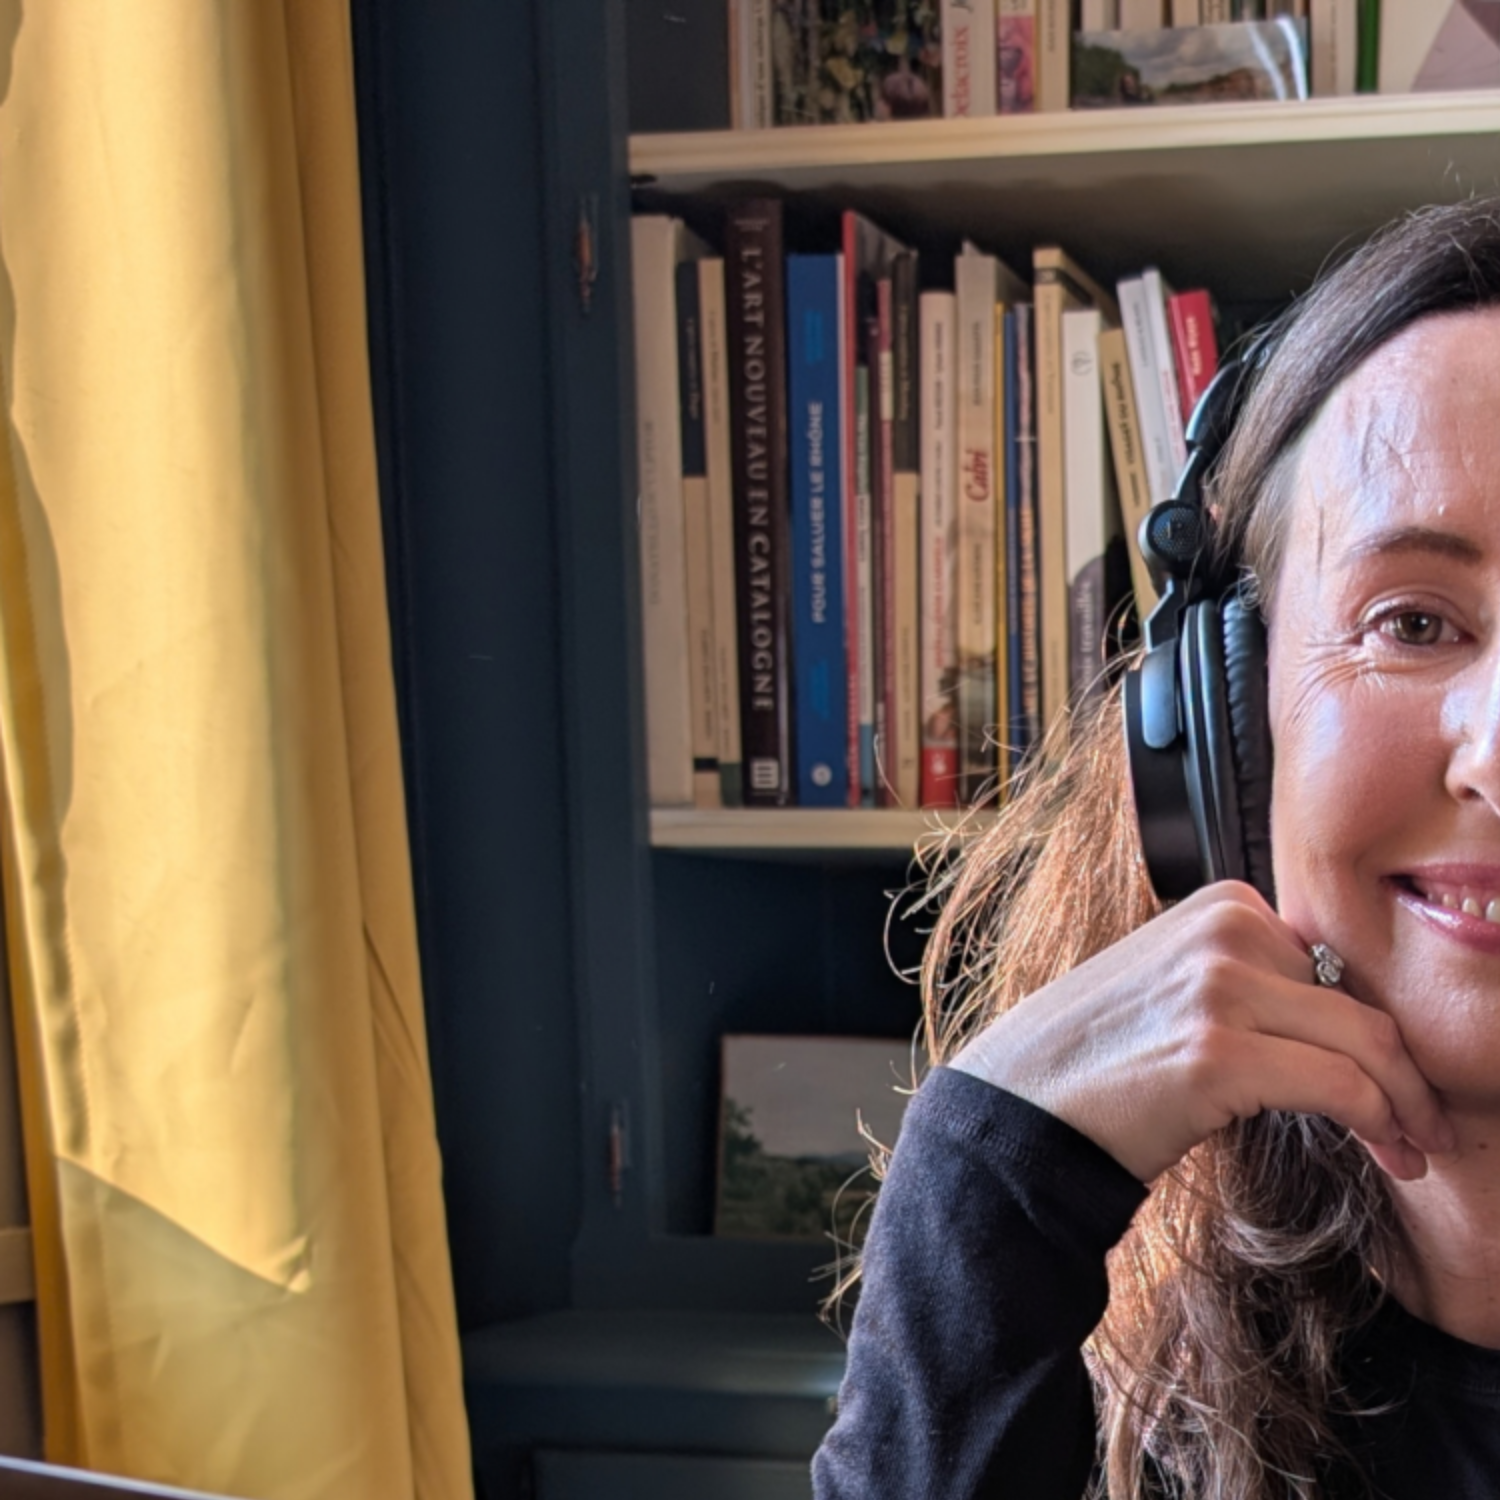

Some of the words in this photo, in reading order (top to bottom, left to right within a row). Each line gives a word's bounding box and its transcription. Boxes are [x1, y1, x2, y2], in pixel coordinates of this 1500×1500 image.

[741, 247, 768, 328] L'ART
[744, 335, 771, 480] NOUVEAU
[806, 401, 824, 467] RHÔNE
[747, 487, 771, 528] EN
[810, 469, 825, 494] LE
[965, 448, 991, 503] Calvi
[810, 496, 826, 569] SALUER
[749, 534, 774, 714] CATALOGNE
[811, 571, 827, 623] POUR
